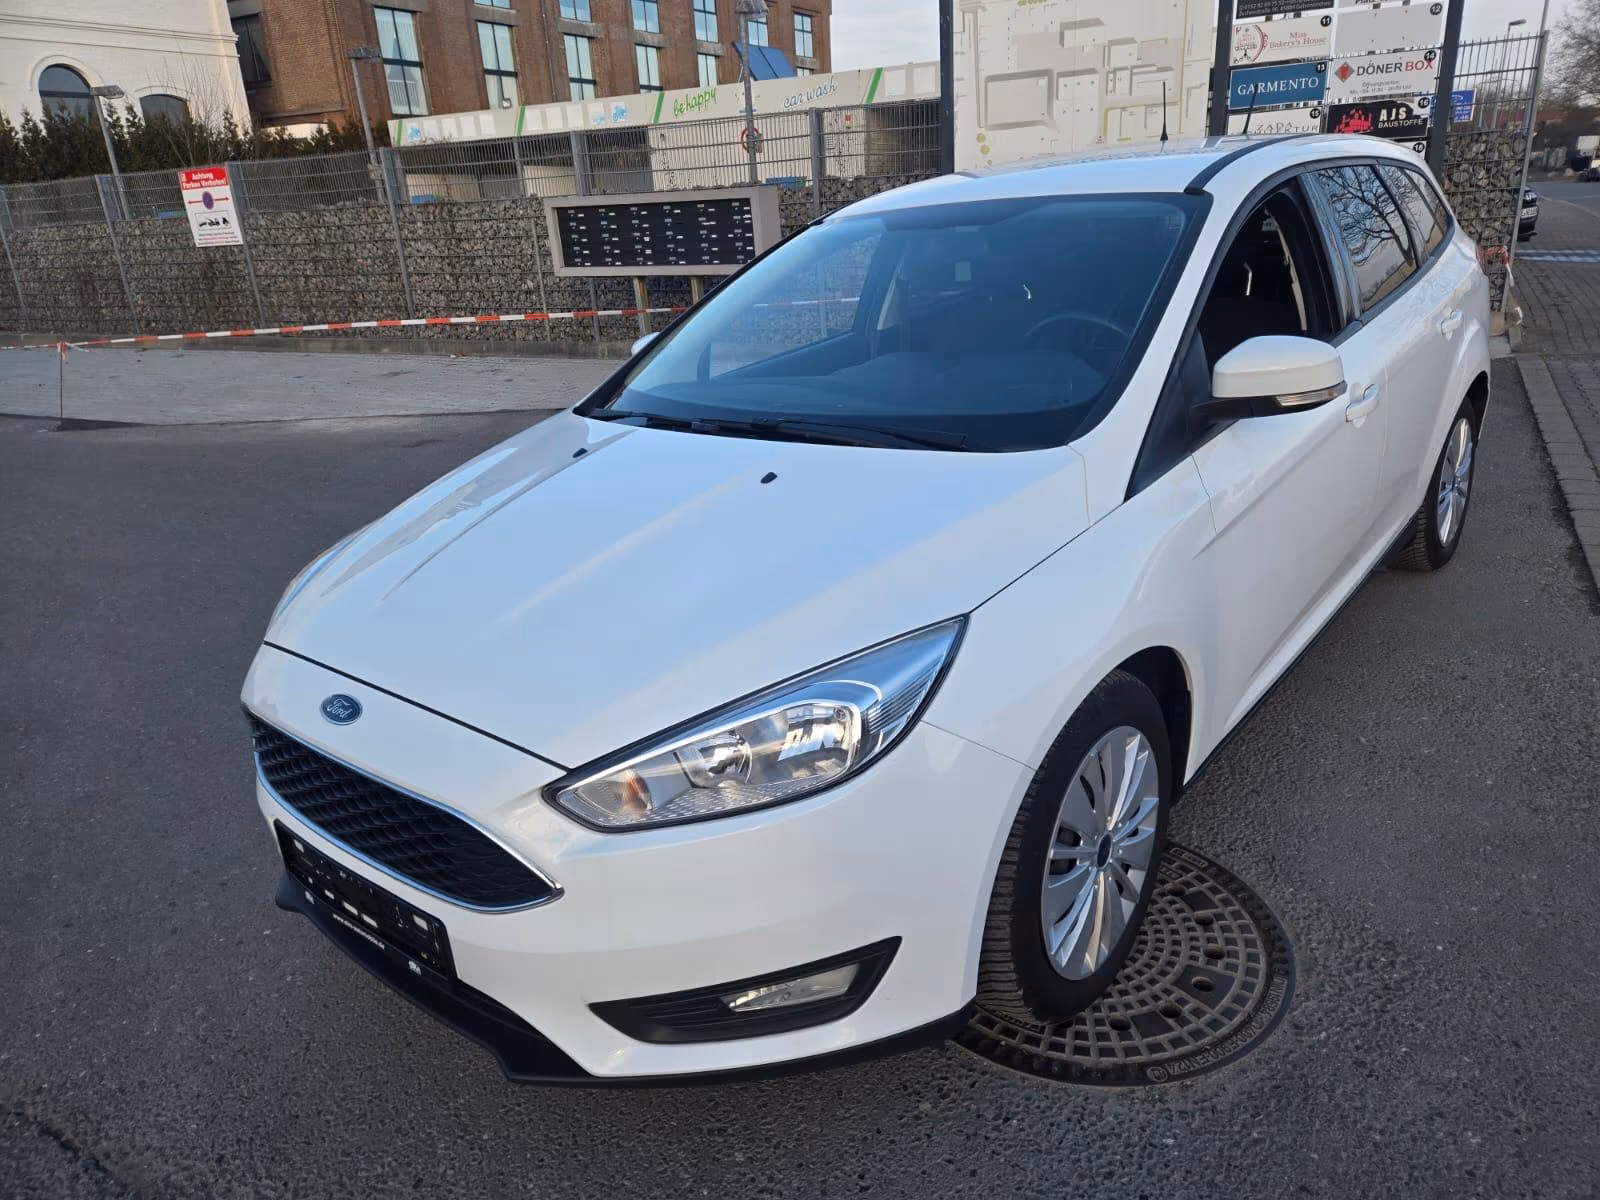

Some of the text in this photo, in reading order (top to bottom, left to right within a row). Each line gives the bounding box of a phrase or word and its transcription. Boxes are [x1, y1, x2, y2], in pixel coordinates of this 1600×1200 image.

[1303, 36, 1328, 45] House
[1356, 60, 1433, 76] DÖNER BOX
[783, 76, 838, 108] car wash
[1237, 77, 1319, 95] GARMENTO
[1380, 107, 1407, 121] AJS
[1378, 119, 1424, 128] BAUSTOFFE
[327, 698, 352, 718] Ford
